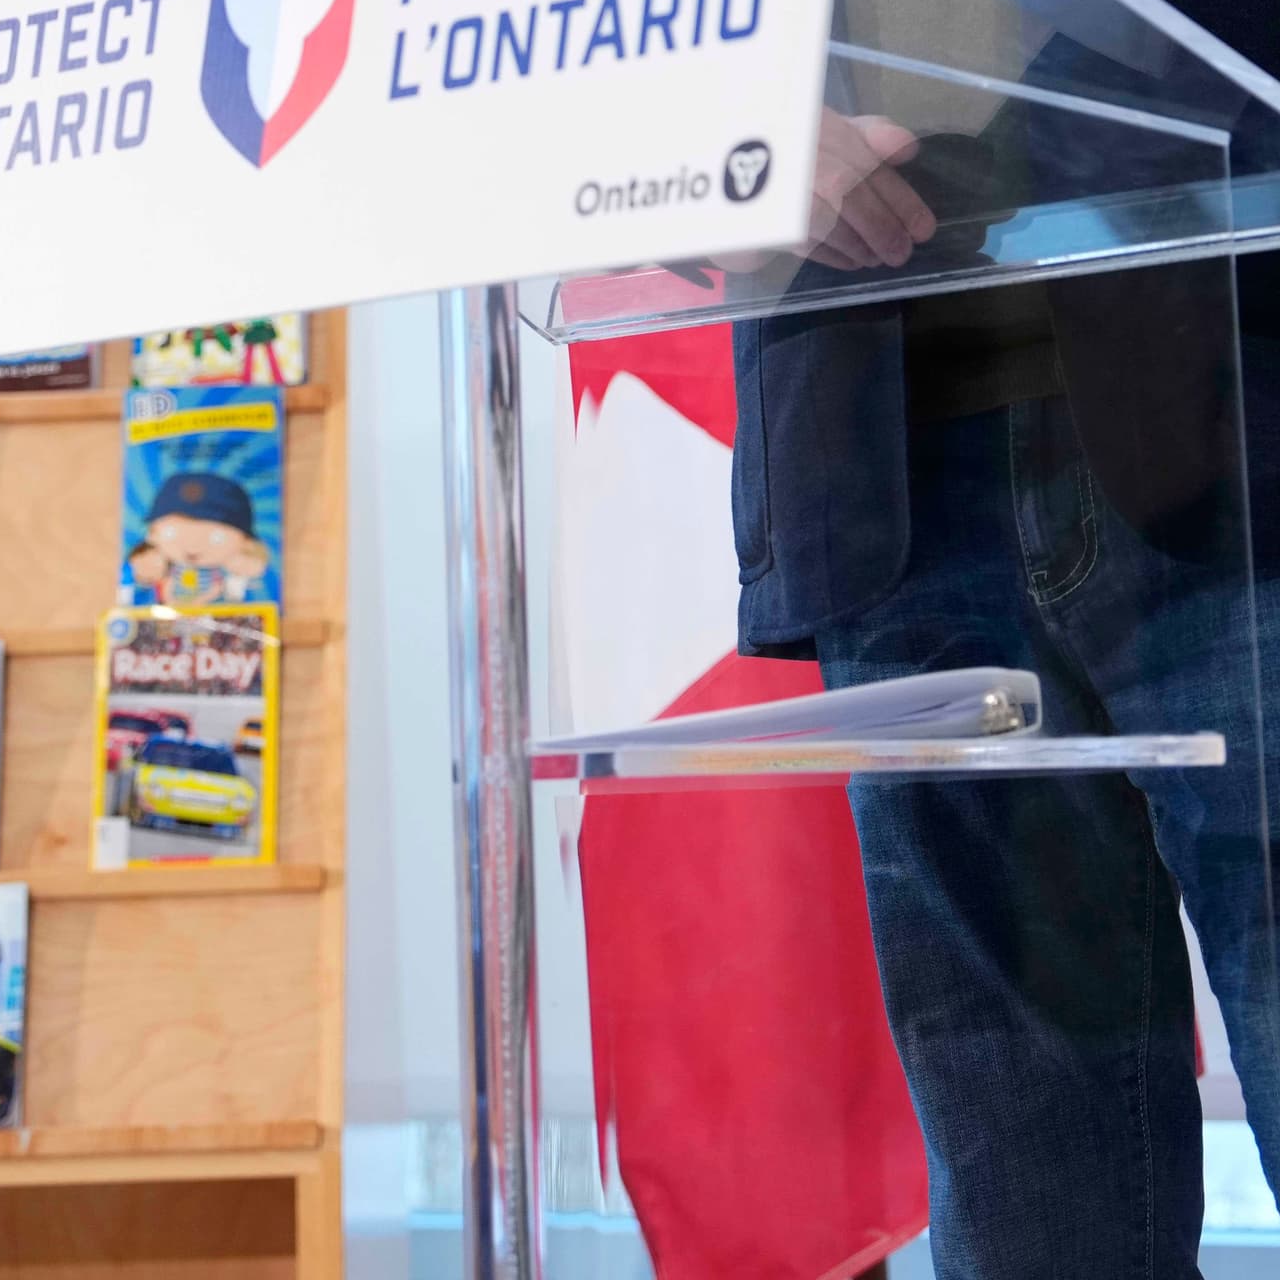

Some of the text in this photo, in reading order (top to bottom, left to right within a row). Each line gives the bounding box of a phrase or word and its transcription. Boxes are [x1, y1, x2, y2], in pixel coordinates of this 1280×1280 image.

[574, 169, 711, 218] Ontario
[113, 645, 261, 687] Race Day
